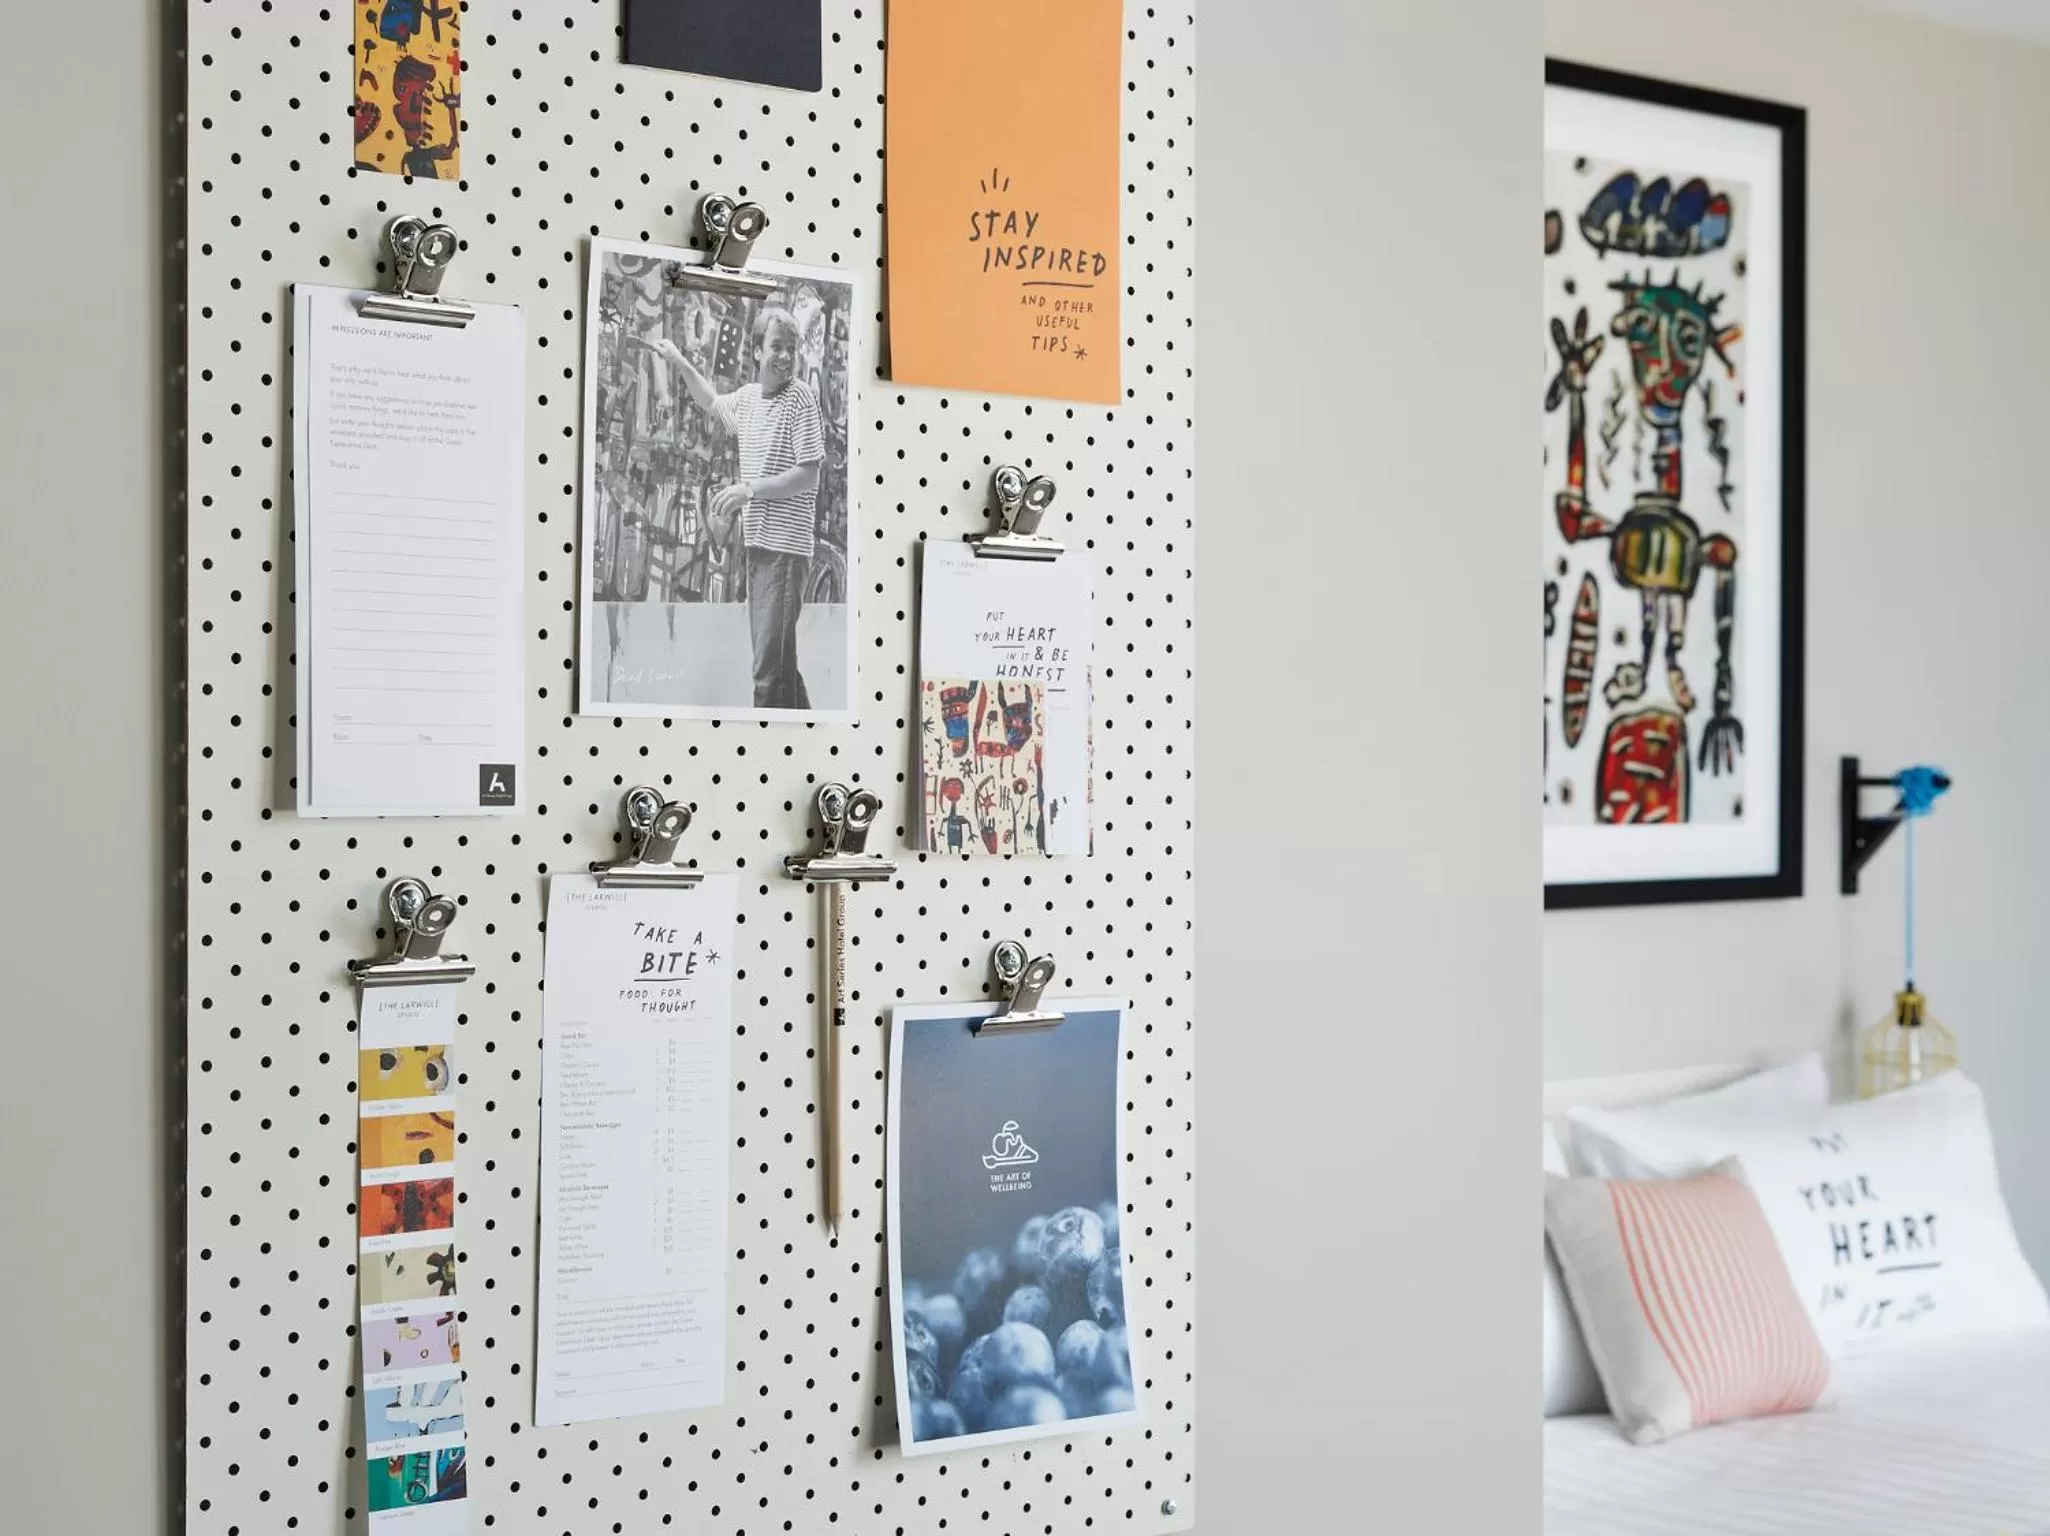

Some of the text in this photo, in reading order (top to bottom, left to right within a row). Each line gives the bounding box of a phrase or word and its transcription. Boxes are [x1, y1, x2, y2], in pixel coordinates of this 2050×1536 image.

[968, 209, 1040, 242] STAY
[983, 245, 1107, 277] INSPIRED
[1020, 294, 1094, 313] AND OTHER
[1036, 315, 1080, 330] USEFUL
[986, 611, 1006, 622] PUT
[975, 625, 1057, 643] YOUR HEART
[1034, 646, 1045, 661] &
[1051, 648, 1070, 662] BE
[632, 921, 703, 945] TAKE A
[618, 988, 683, 1000] FOOD FOR
[640, 999, 697, 1014] THOUGHT
[990, 1171, 1031, 1182] THE ART OF
[990, 1181, 1032, 1192] WELLBEING
[1798, 1174, 1880, 1212] YOUR
[1828, 1213, 1938, 1268] HEART
